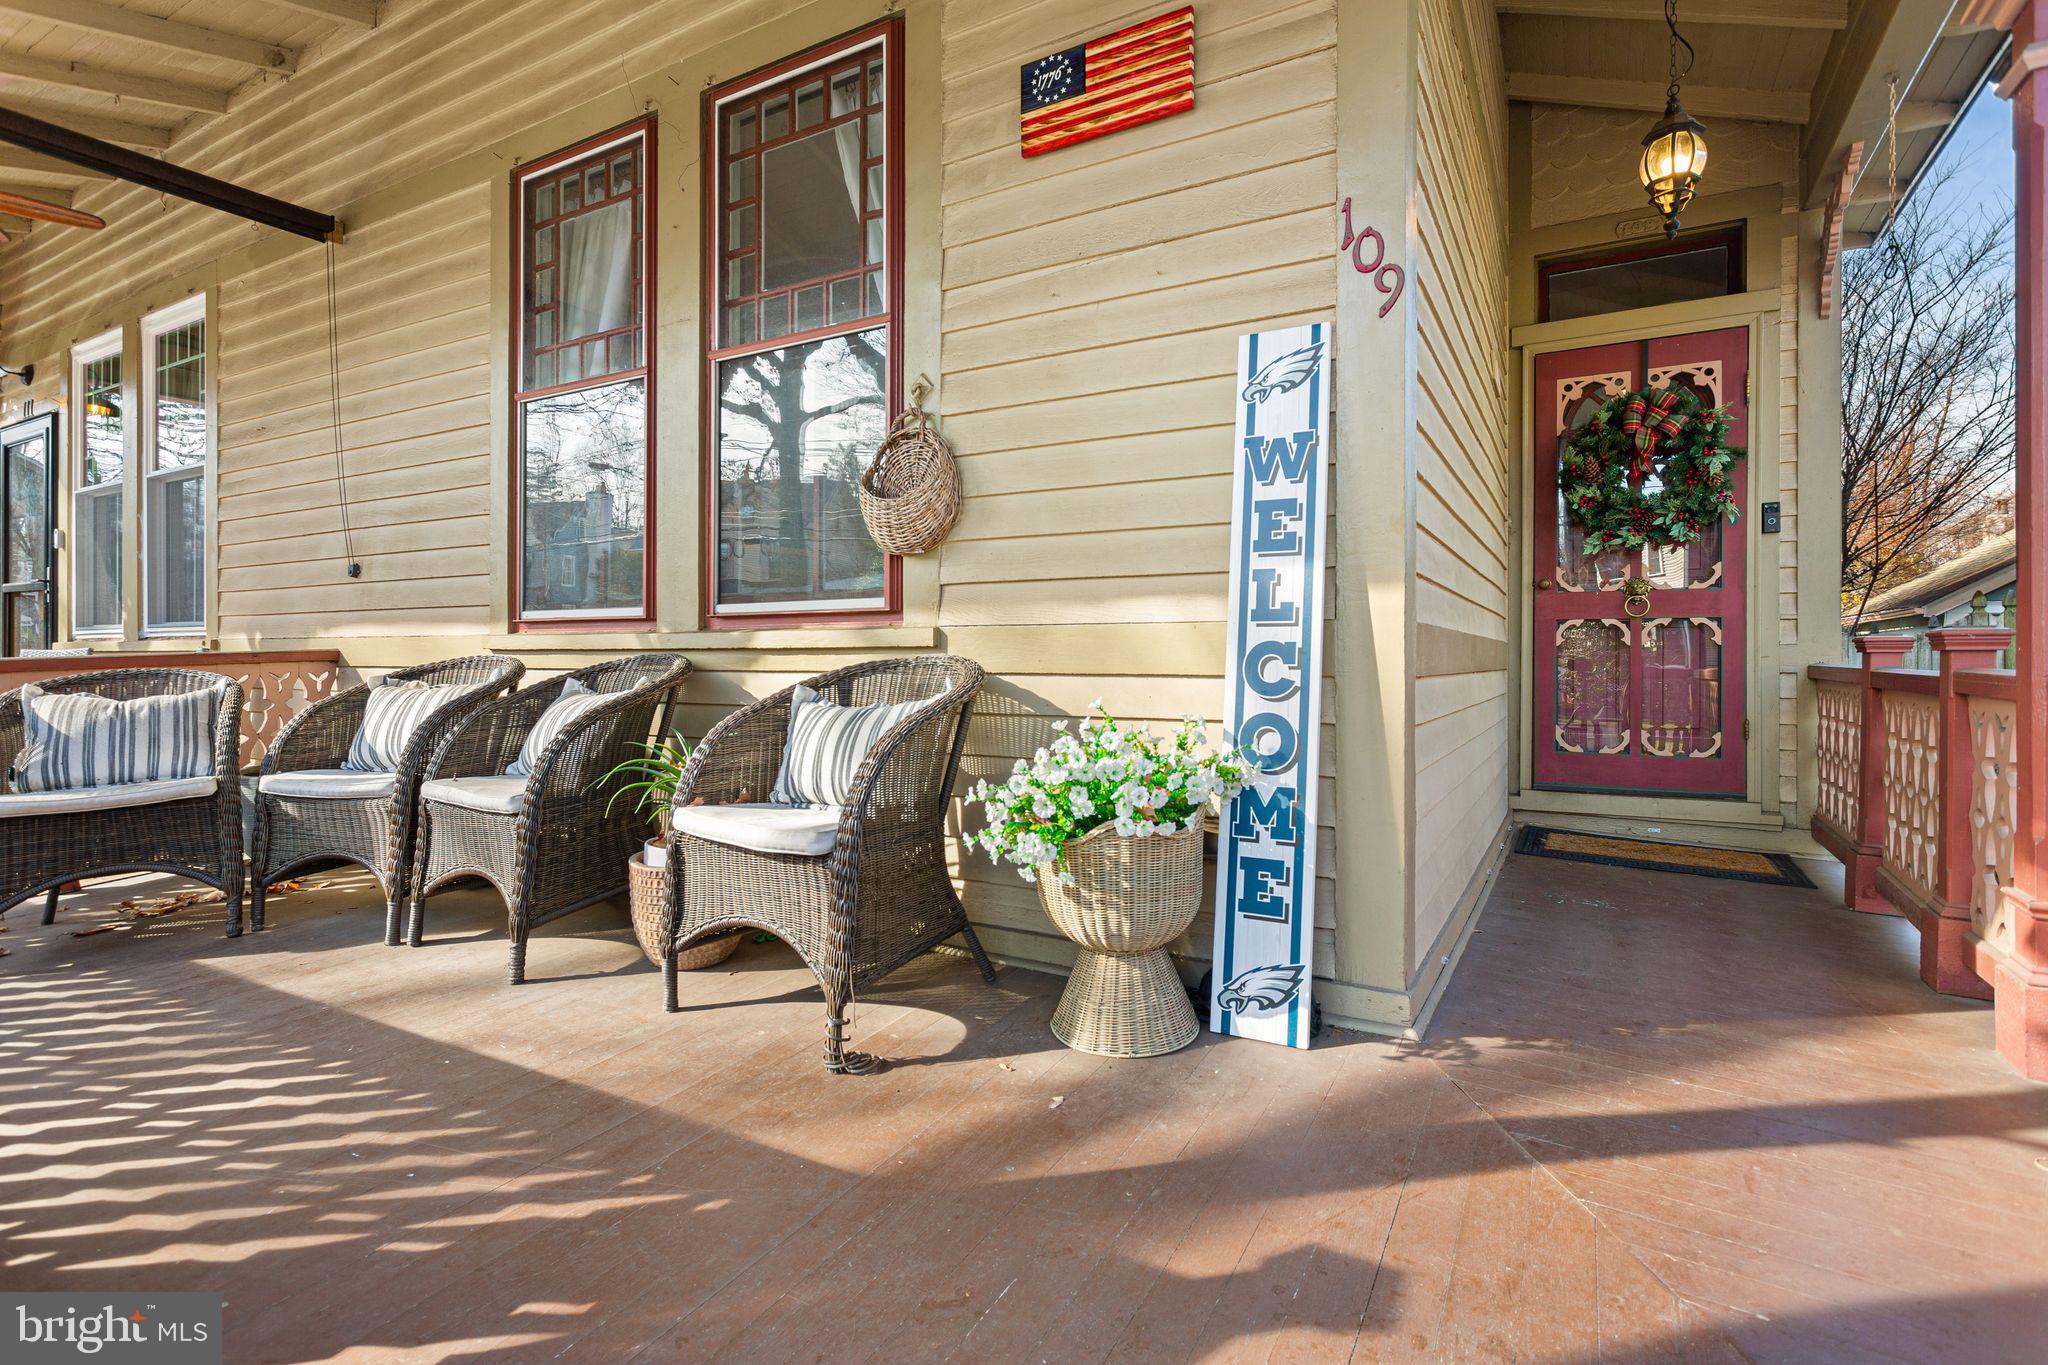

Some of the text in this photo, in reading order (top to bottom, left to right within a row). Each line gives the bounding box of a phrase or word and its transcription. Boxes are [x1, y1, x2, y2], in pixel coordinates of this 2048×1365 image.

[1037, 65, 1065, 91] 1776
[1341, 197, 1405, 318] 109
[1233, 430, 1318, 923] WELCOME
